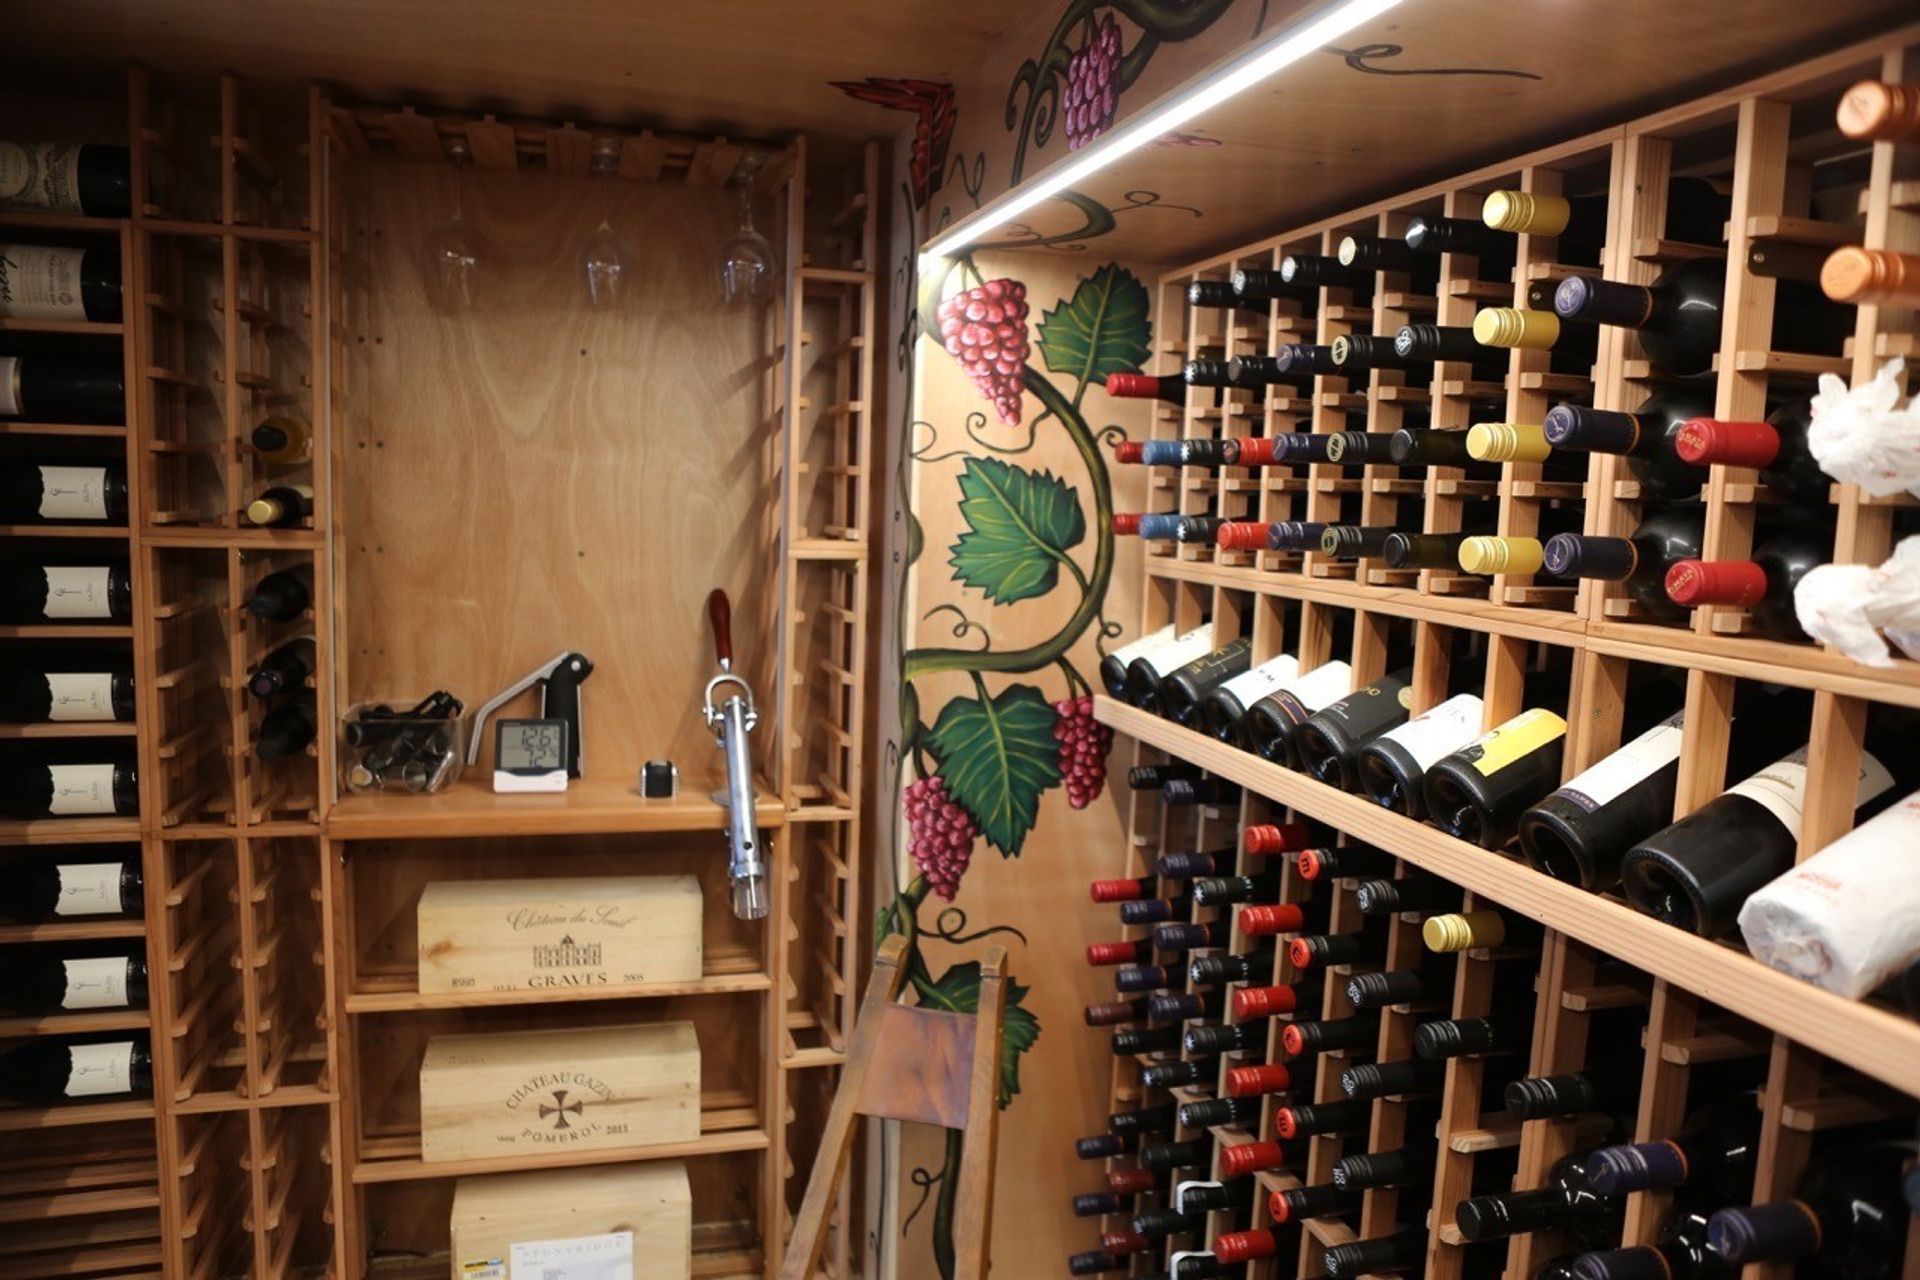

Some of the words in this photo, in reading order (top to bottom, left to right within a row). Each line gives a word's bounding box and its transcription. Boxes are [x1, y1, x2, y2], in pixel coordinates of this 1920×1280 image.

[528, 972, 608, 988] GRAVES
[506, 1072, 570, 1110] CHATEAU
[521, 1122, 602, 1143] POMEROL
